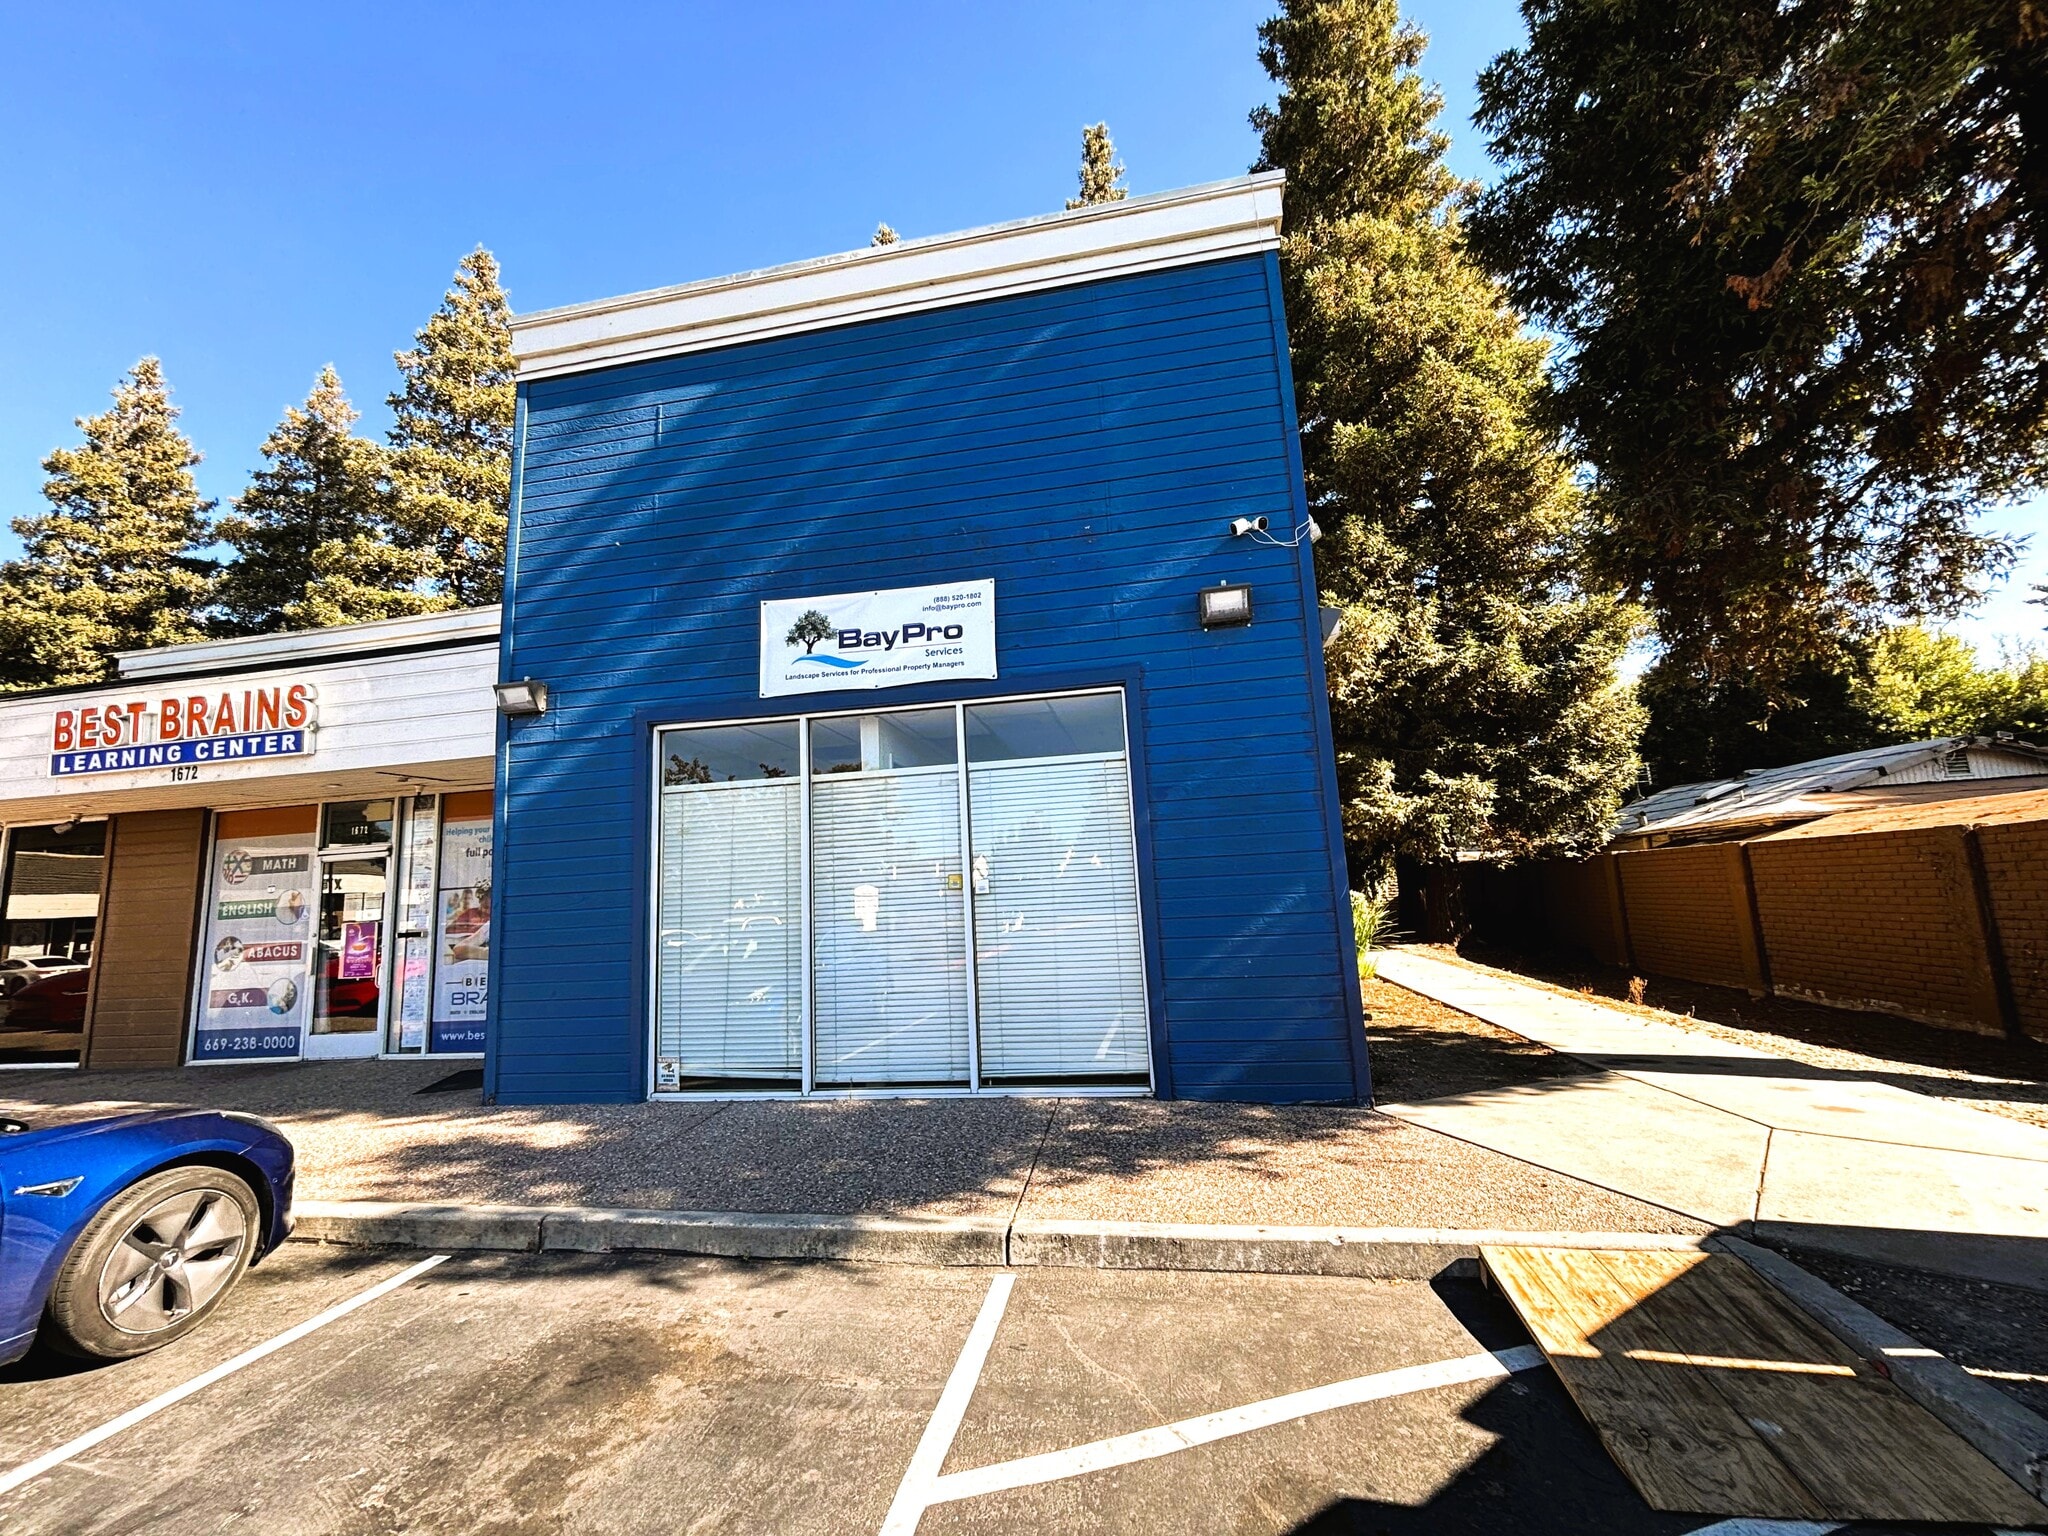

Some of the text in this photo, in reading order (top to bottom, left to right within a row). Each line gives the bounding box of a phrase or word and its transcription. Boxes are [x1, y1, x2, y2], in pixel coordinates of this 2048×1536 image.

[838, 622, 963, 651] BayPro
[925, 647, 963, 657] Services
[785, 660, 965, 681] Landscape Services for Professional Property Managers
[53, 684, 308, 751] BEST BRAINS
[59, 733, 297, 773] LEARNING CENTER
[170, 766, 198, 782] 1672
[351, 825, 369, 835] 1672
[446, 826, 490, 837] Helping your
[465, 847, 481, 858] full
[262, 858, 297, 871] MATH
[222, 902, 273, 917] ENGLISH
[248, 945, 298, 959] ABACUS
[441, 1030, 486, 1041] www.bes
[204, 1035, 296, 1051] 669-238-0000
